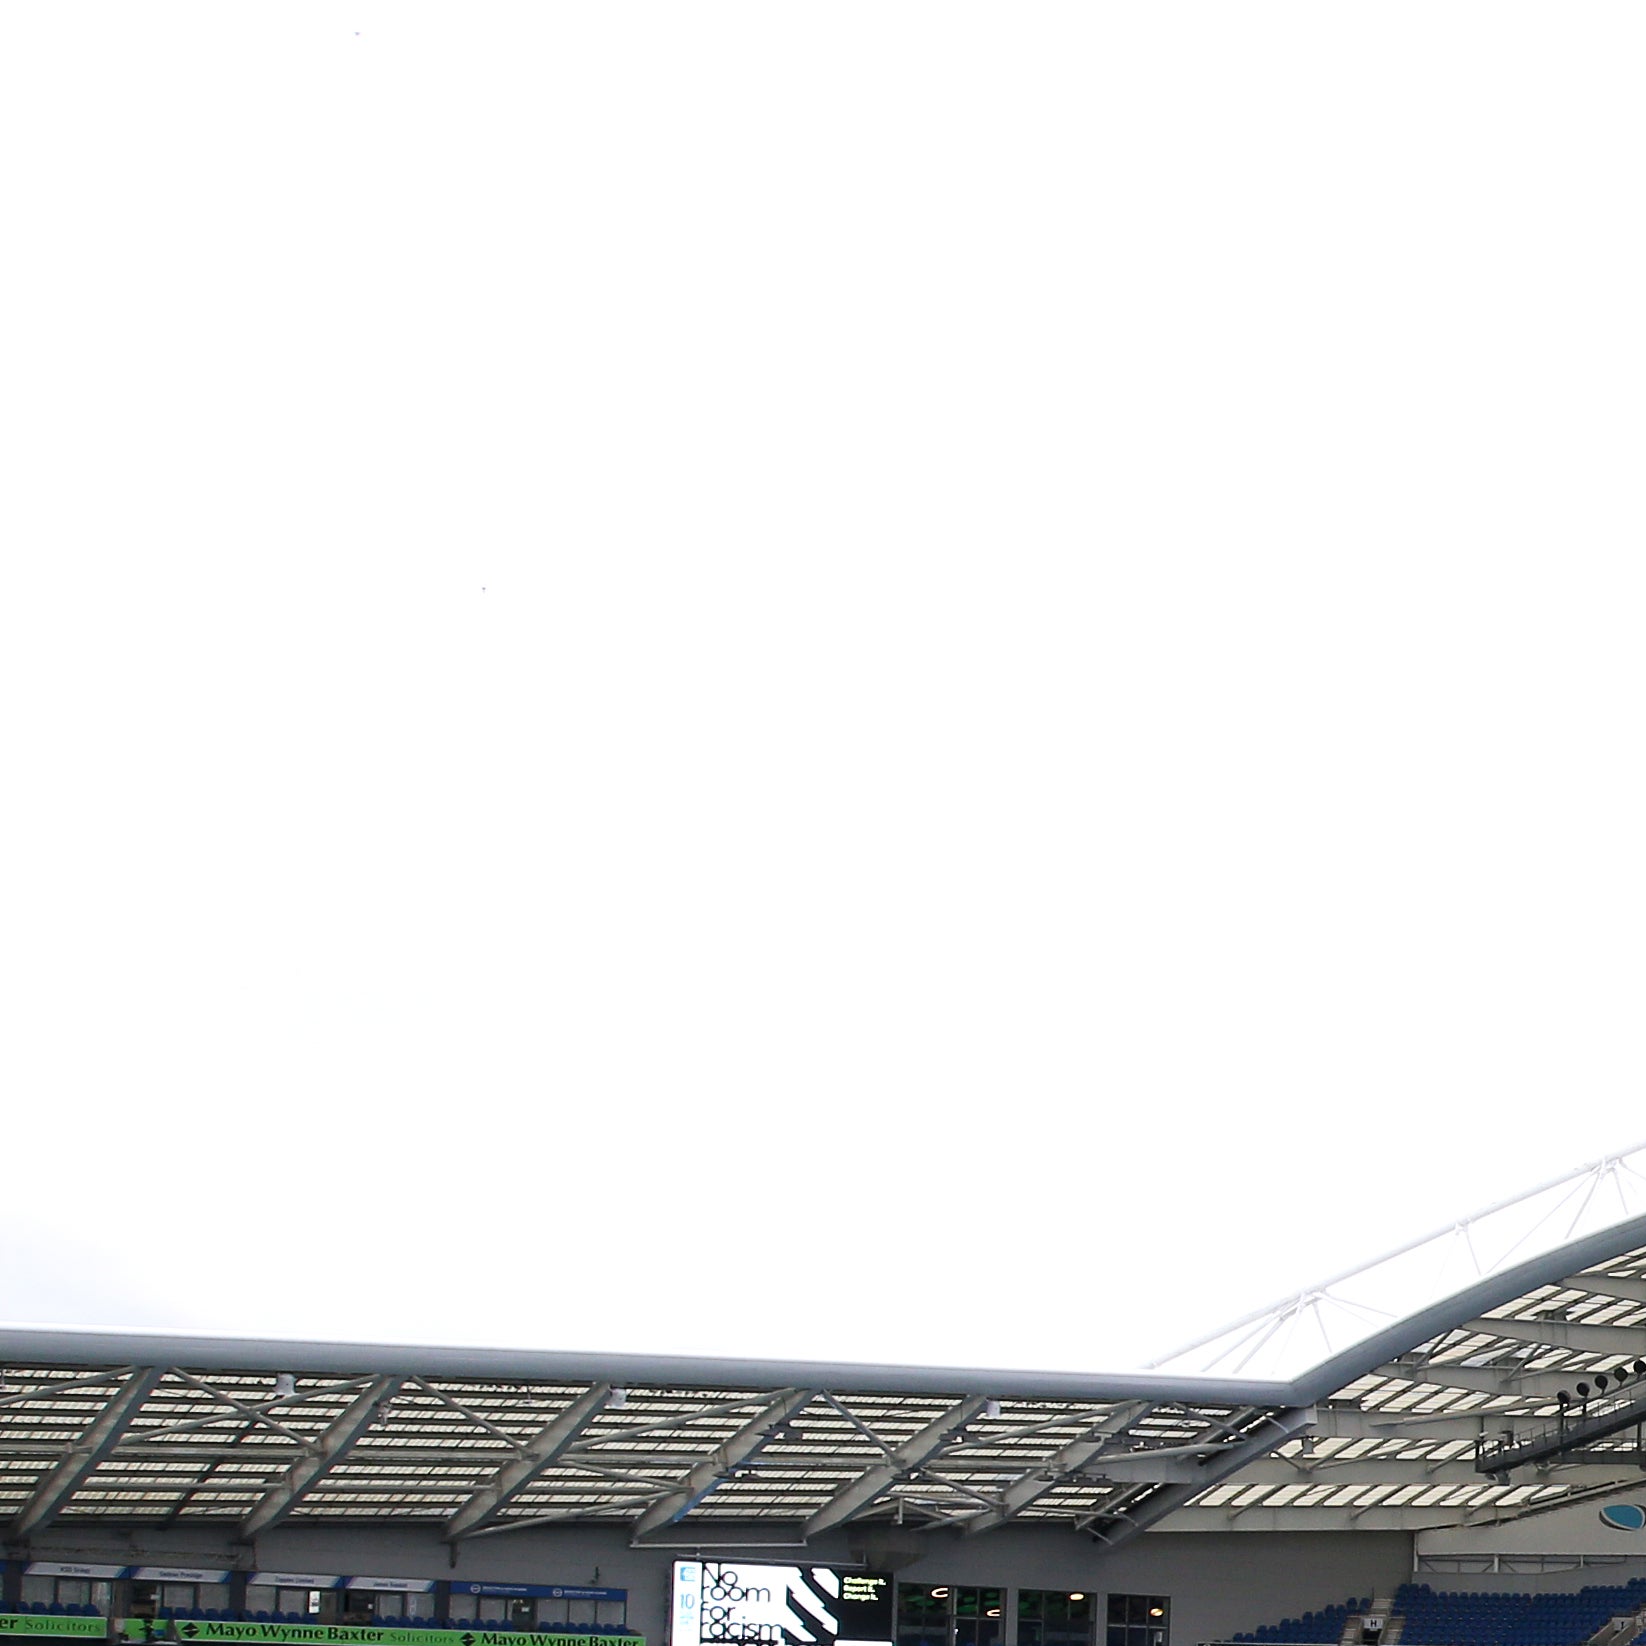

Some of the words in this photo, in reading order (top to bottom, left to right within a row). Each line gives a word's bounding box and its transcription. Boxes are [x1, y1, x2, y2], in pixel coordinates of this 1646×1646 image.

[702, 1562, 738, 1587] No
[700, 1586, 771, 1602] room
[700, 1601, 736, 1621] for
[25, 1618, 101, 1633] Solicitors
[206, 1622, 257, 1641] Mayo
[261, 1624, 325, 1642] Wynne
[327, 1627, 384, 1643] Baxter
[390, 1630, 454, 1645] Solicitors
[700, 1615, 784, 1640] racism
[1370, 1619, 1377, 1628] H
